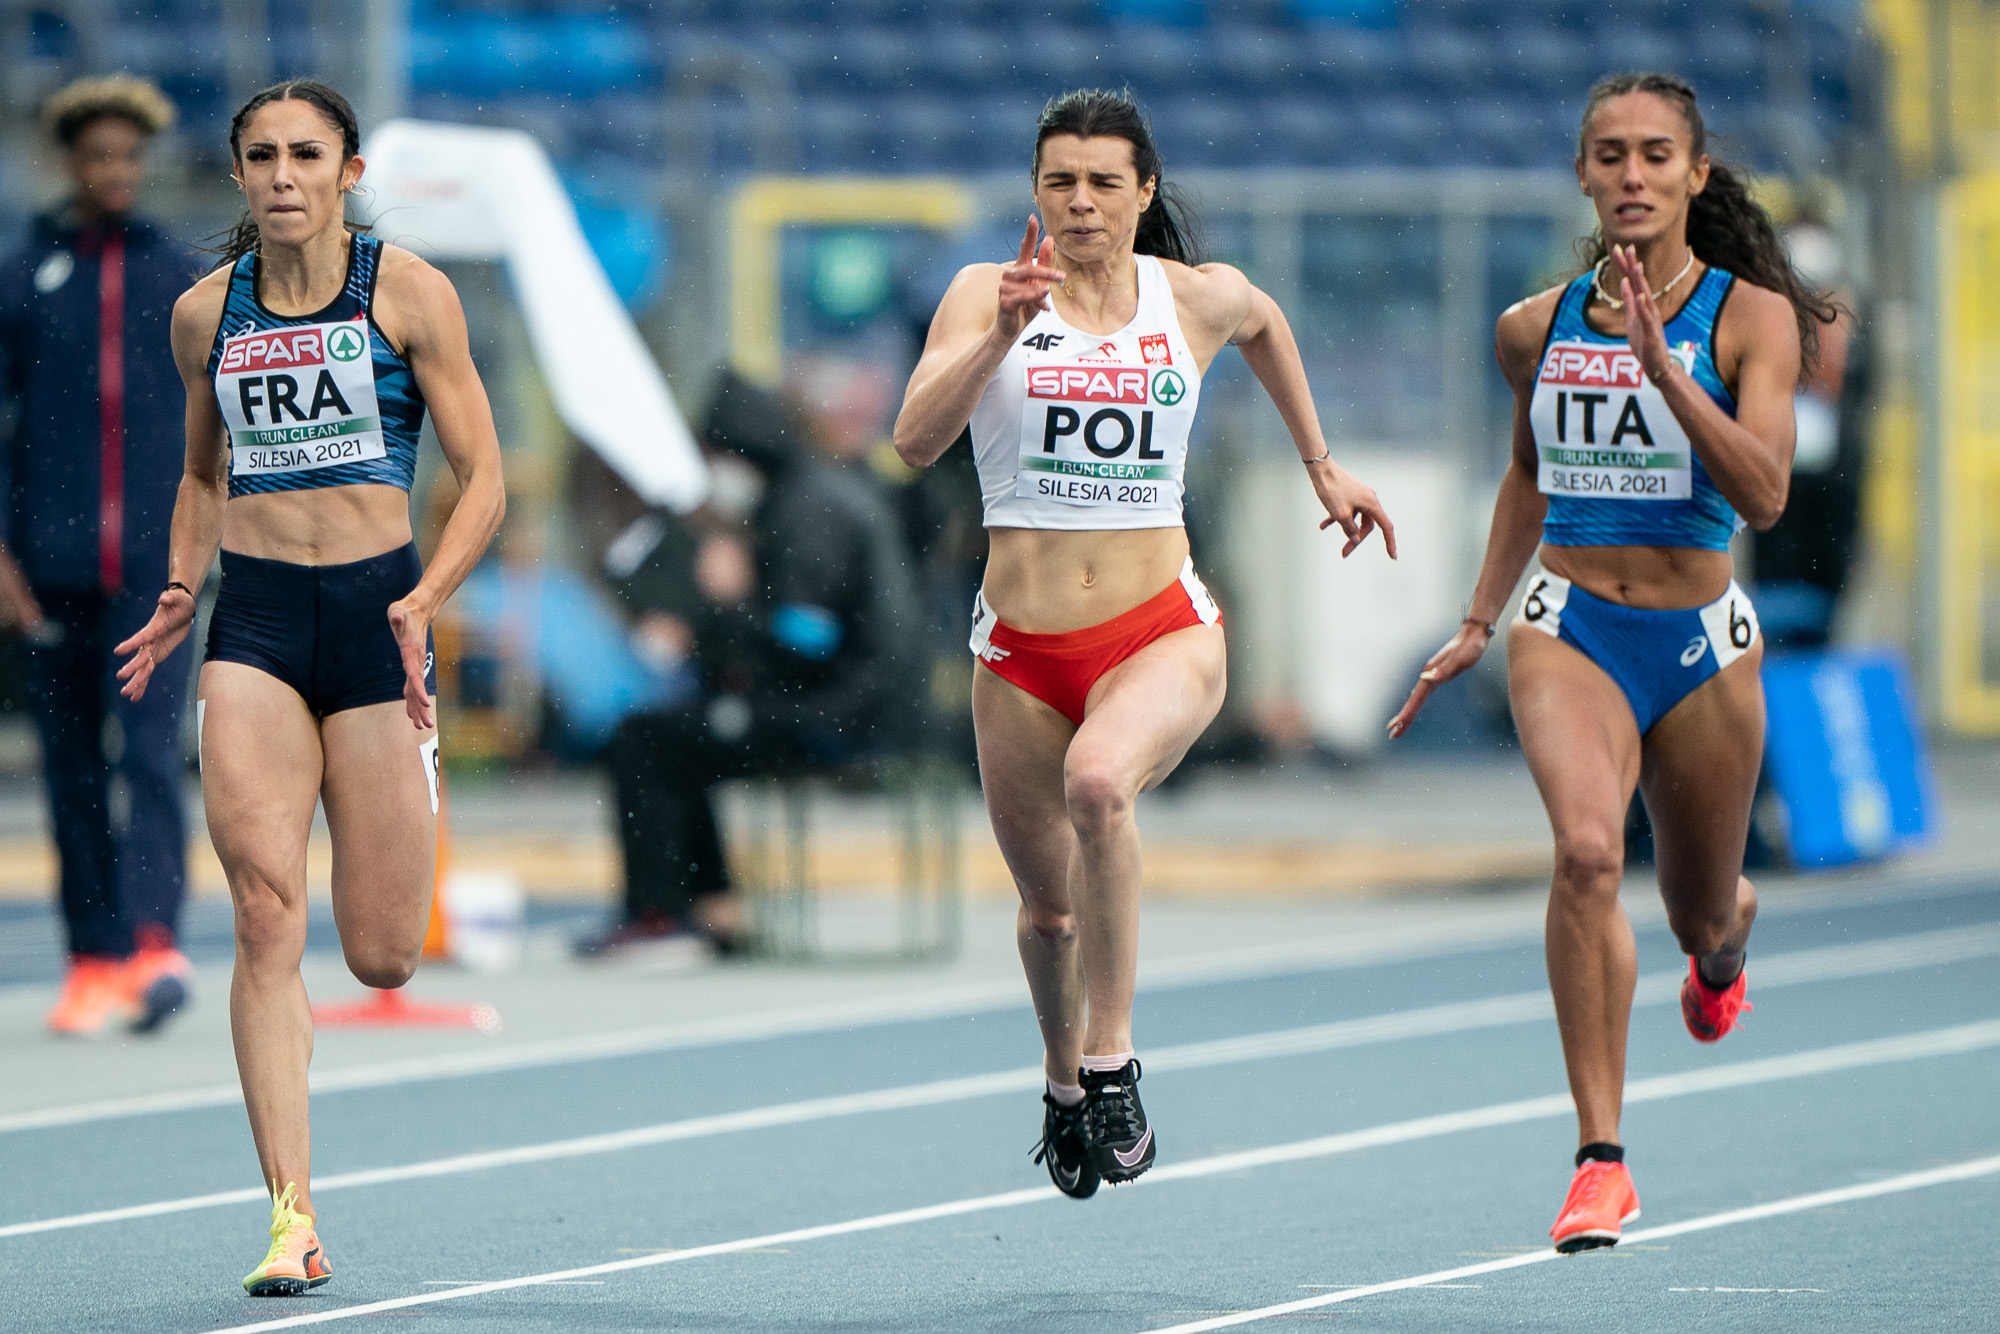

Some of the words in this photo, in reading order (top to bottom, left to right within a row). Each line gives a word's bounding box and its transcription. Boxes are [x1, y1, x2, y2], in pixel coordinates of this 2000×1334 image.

[223, 334, 321, 370] SPAR
[1022, 332, 1065, 351] 4F
[1140, 334, 1166, 343] POLSKA
[1542, 351, 1641, 384] SPAR
[238, 368, 353, 426] FRA
[1031, 370, 1146, 400] SPAR
[1043, 405, 1164, 460] POL
[1556, 391, 1656, 447] ITA
[254, 432, 260, 444] I
[260, 430, 287, 444] RUN
[249, 448, 312, 469] SILESIA
[315, 439, 362, 463] 2021
[1053, 461, 1058, 472] I
[1062, 462, 1095, 476] RUN
[1562, 450, 1595, 466] RUN
[1038, 478, 1112, 501] SILESIA
[1117, 485, 1158, 504] 2021
[1551, 470, 1614, 491] SILESIA
[1619, 473, 1667, 494] 2021
[1524, 579, 1548, 622] 6
[1729, 598, 1751, 649] 6
